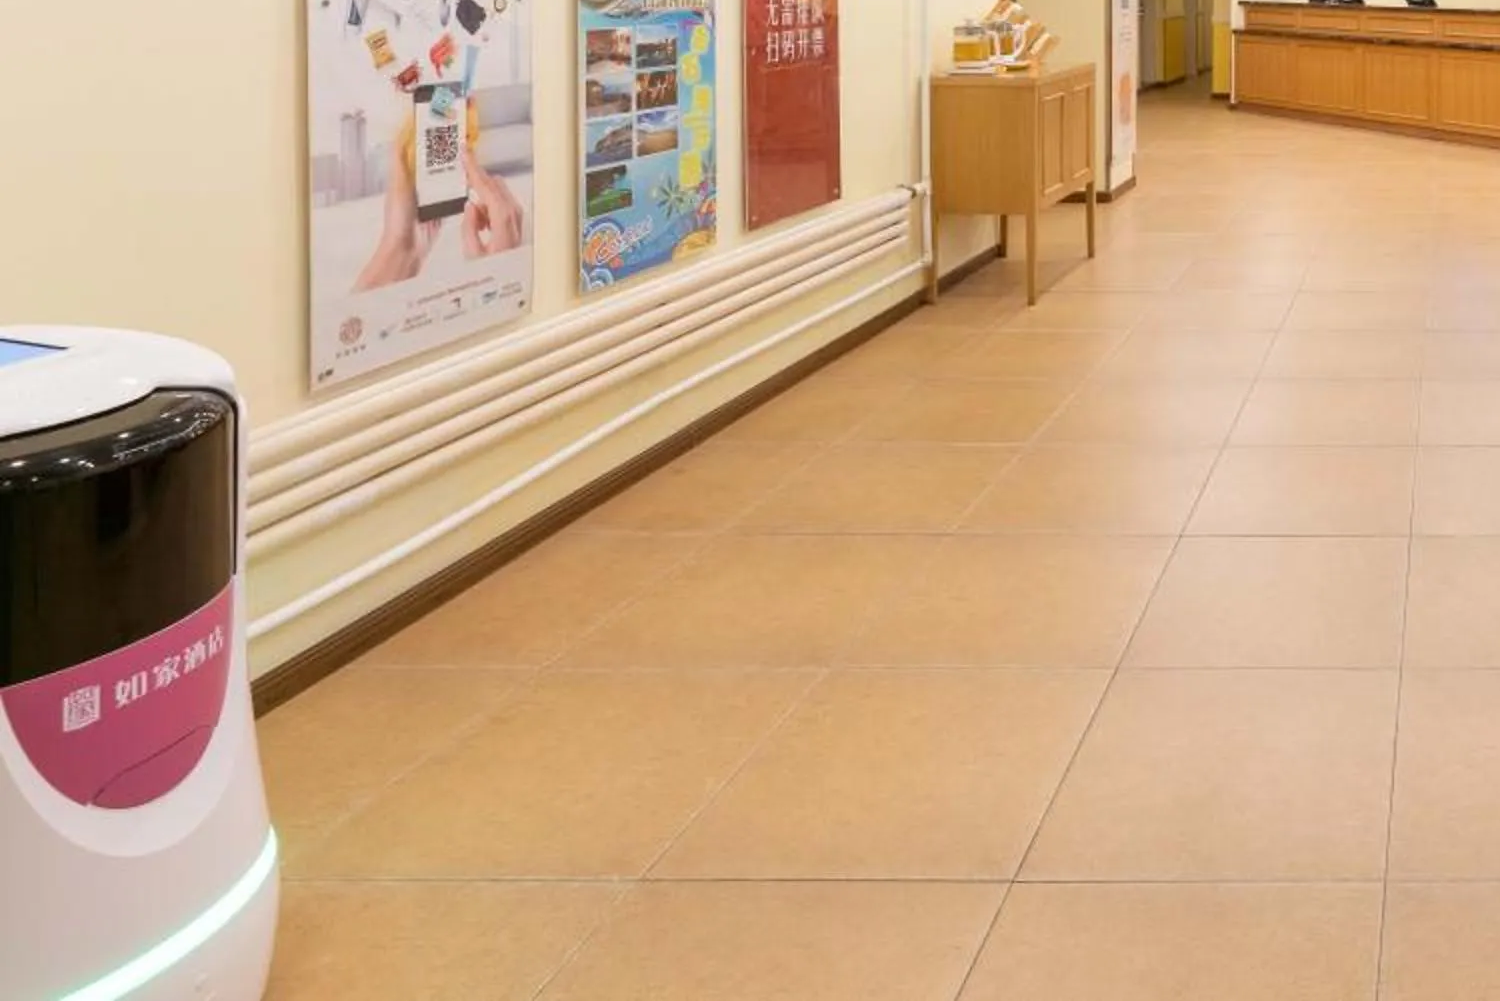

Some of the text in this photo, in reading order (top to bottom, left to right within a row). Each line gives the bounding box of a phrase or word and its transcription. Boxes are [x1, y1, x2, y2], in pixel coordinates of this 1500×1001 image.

[766, 28, 825, 64] 扫码开票
[115, 625, 224, 709] 如家酒店
